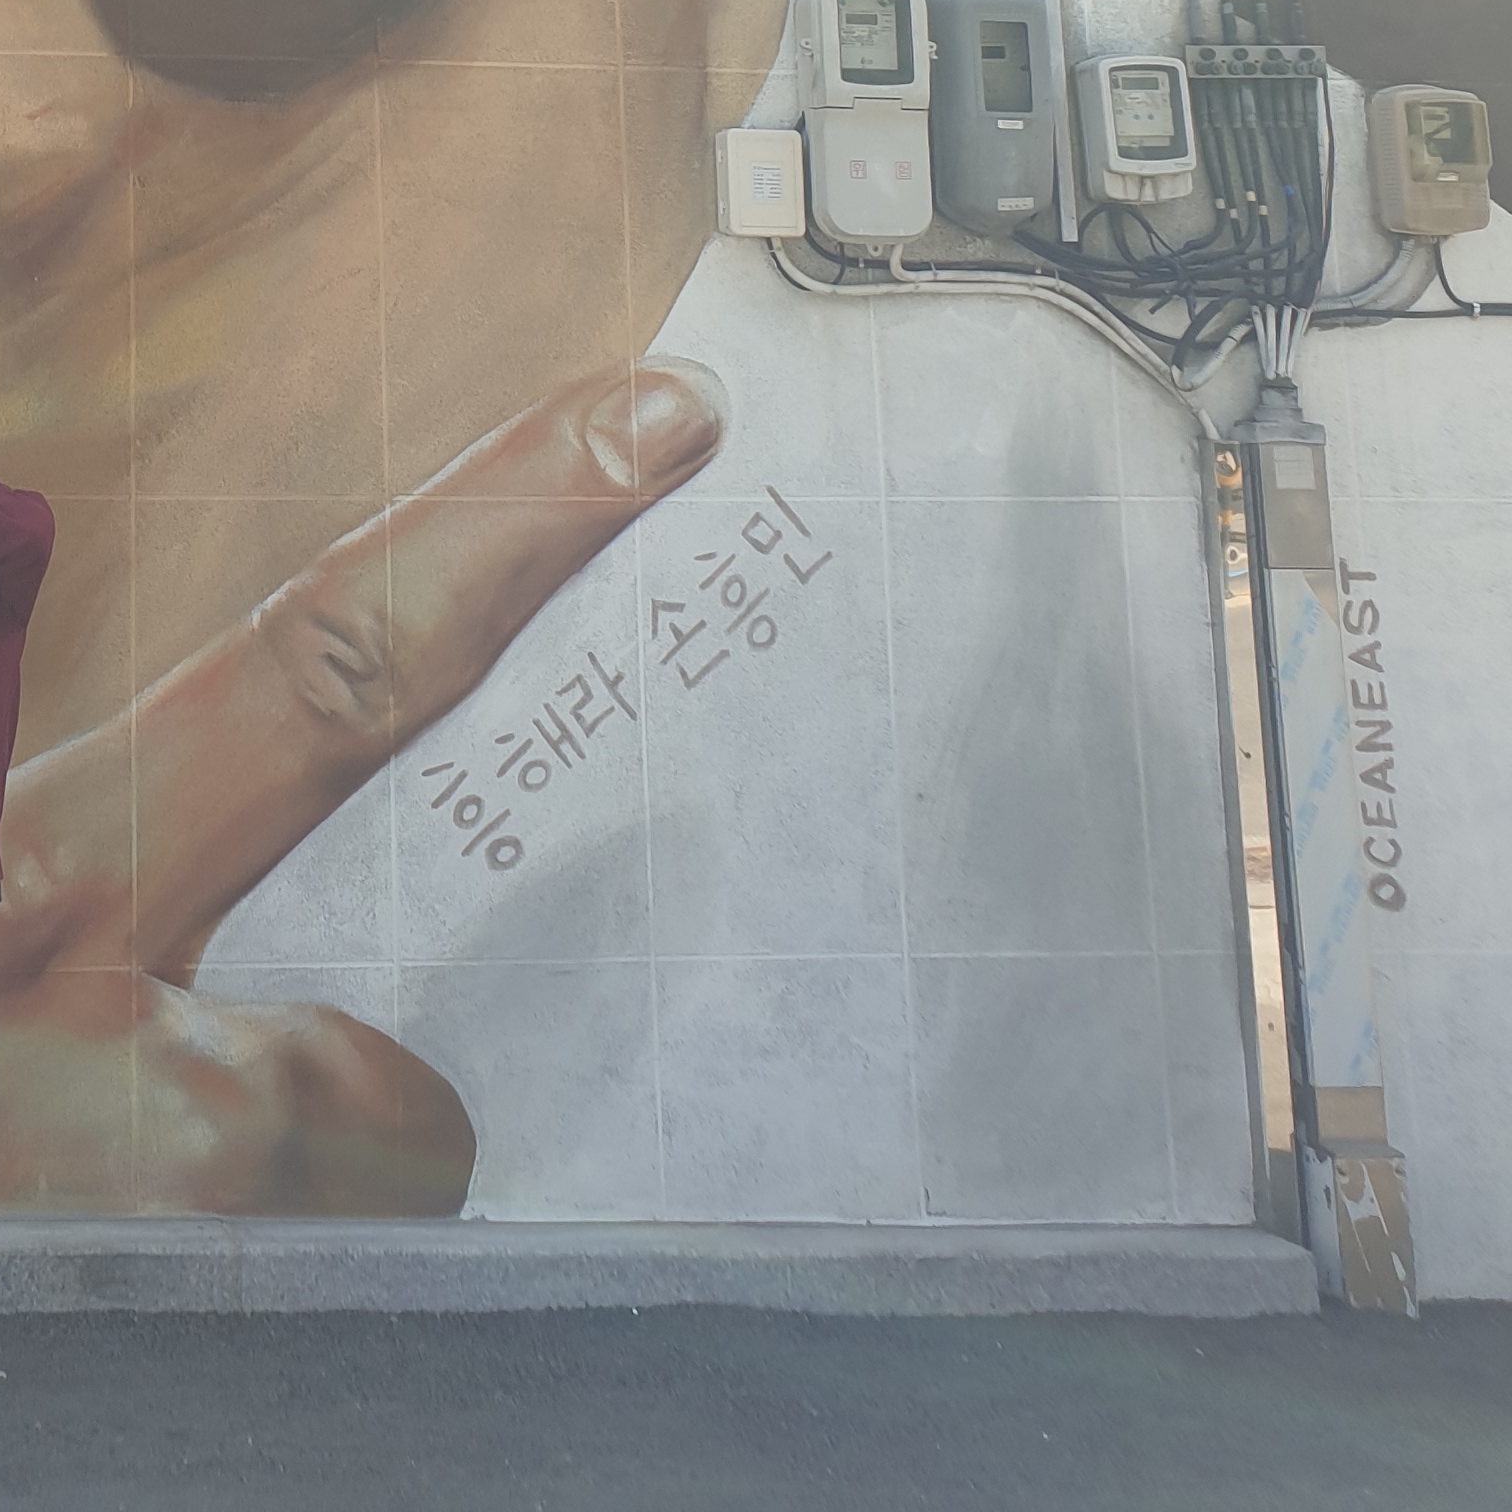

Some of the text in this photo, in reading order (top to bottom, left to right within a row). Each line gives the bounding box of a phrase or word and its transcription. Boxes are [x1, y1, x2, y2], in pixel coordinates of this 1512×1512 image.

[421, 485, 833, 872] 흥해라 손흥민
[1339, 556, 1407, 913] OCEANEAST
